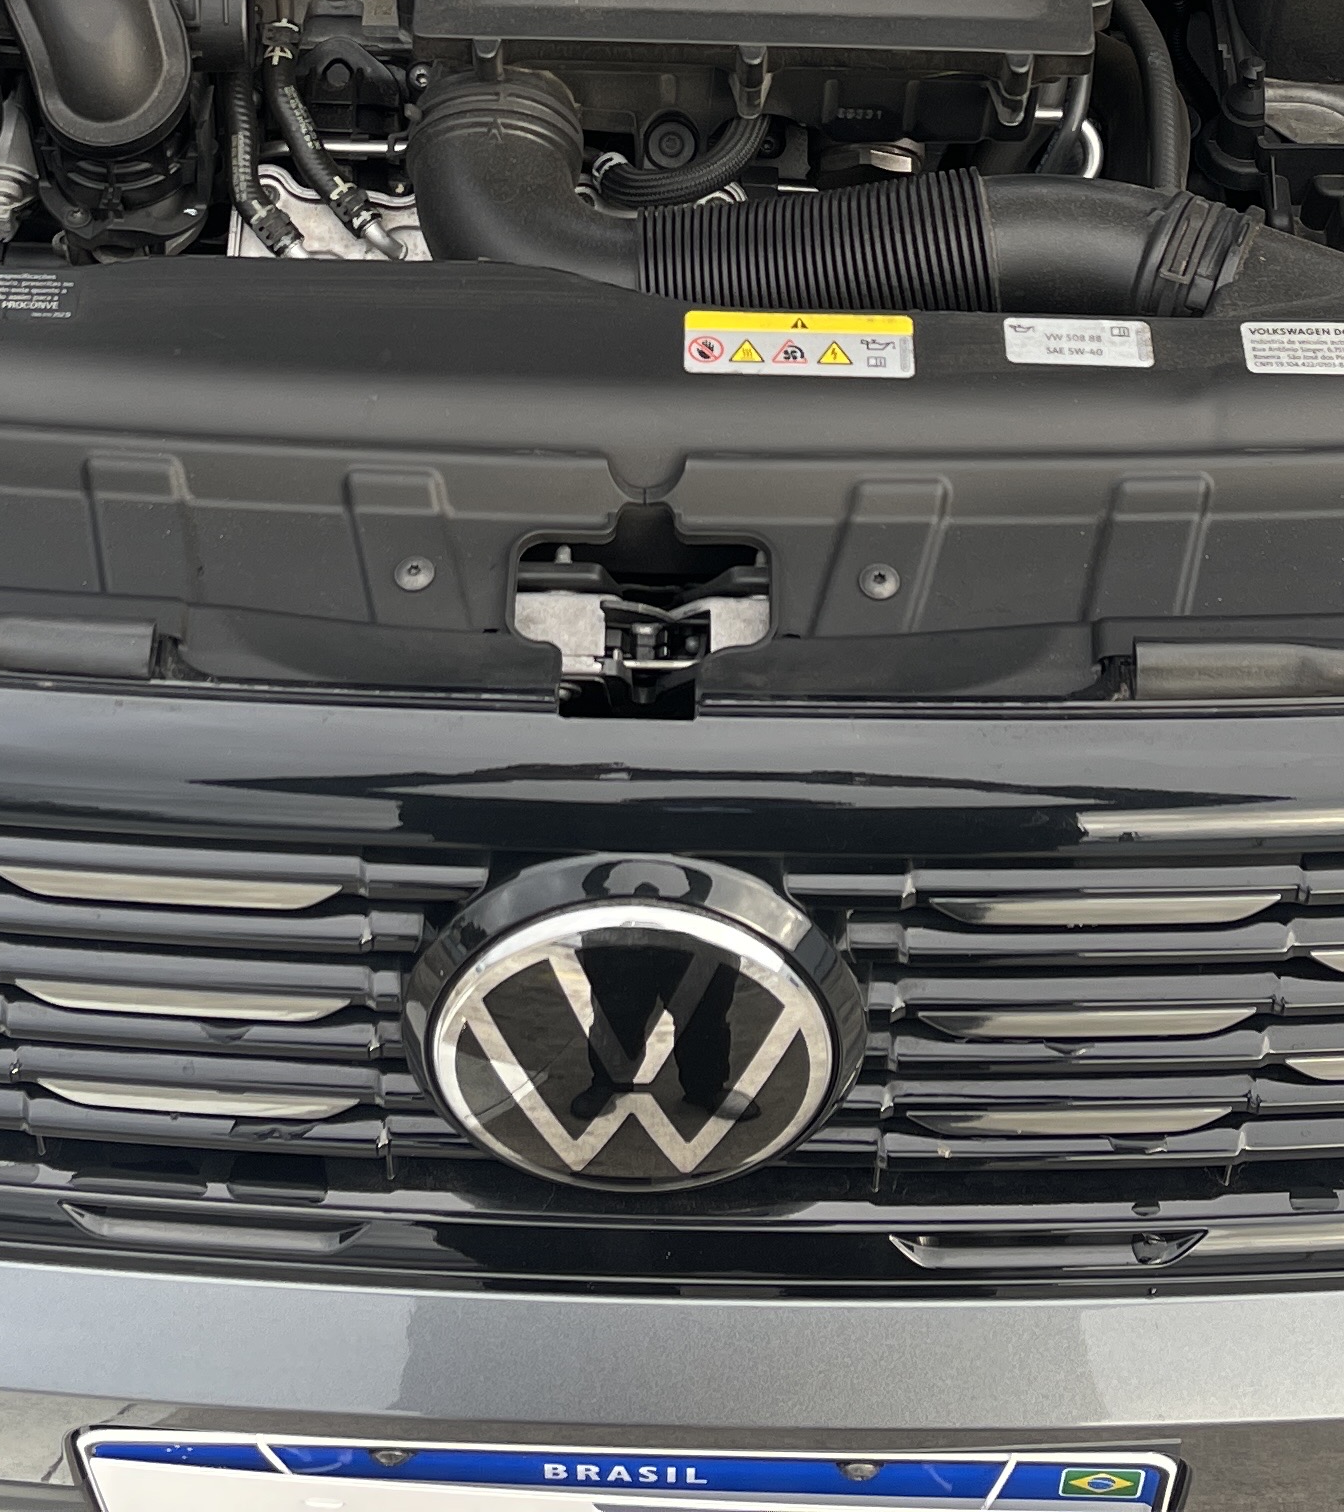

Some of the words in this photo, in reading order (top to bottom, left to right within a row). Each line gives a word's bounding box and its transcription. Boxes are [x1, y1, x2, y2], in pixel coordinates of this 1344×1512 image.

[1, 301, 59, 310] PROCONVE
[1249, 328, 1331, 336] VOLKSWAGEN
[1044, 333, 1062, 341] VW
[1066, 333, 1086, 342] 508
[1046, 347, 1065, 355] SAE
[1068, 348, 1103, 356] 5W-40
[543, 1463, 708, 1485] BRASIL
